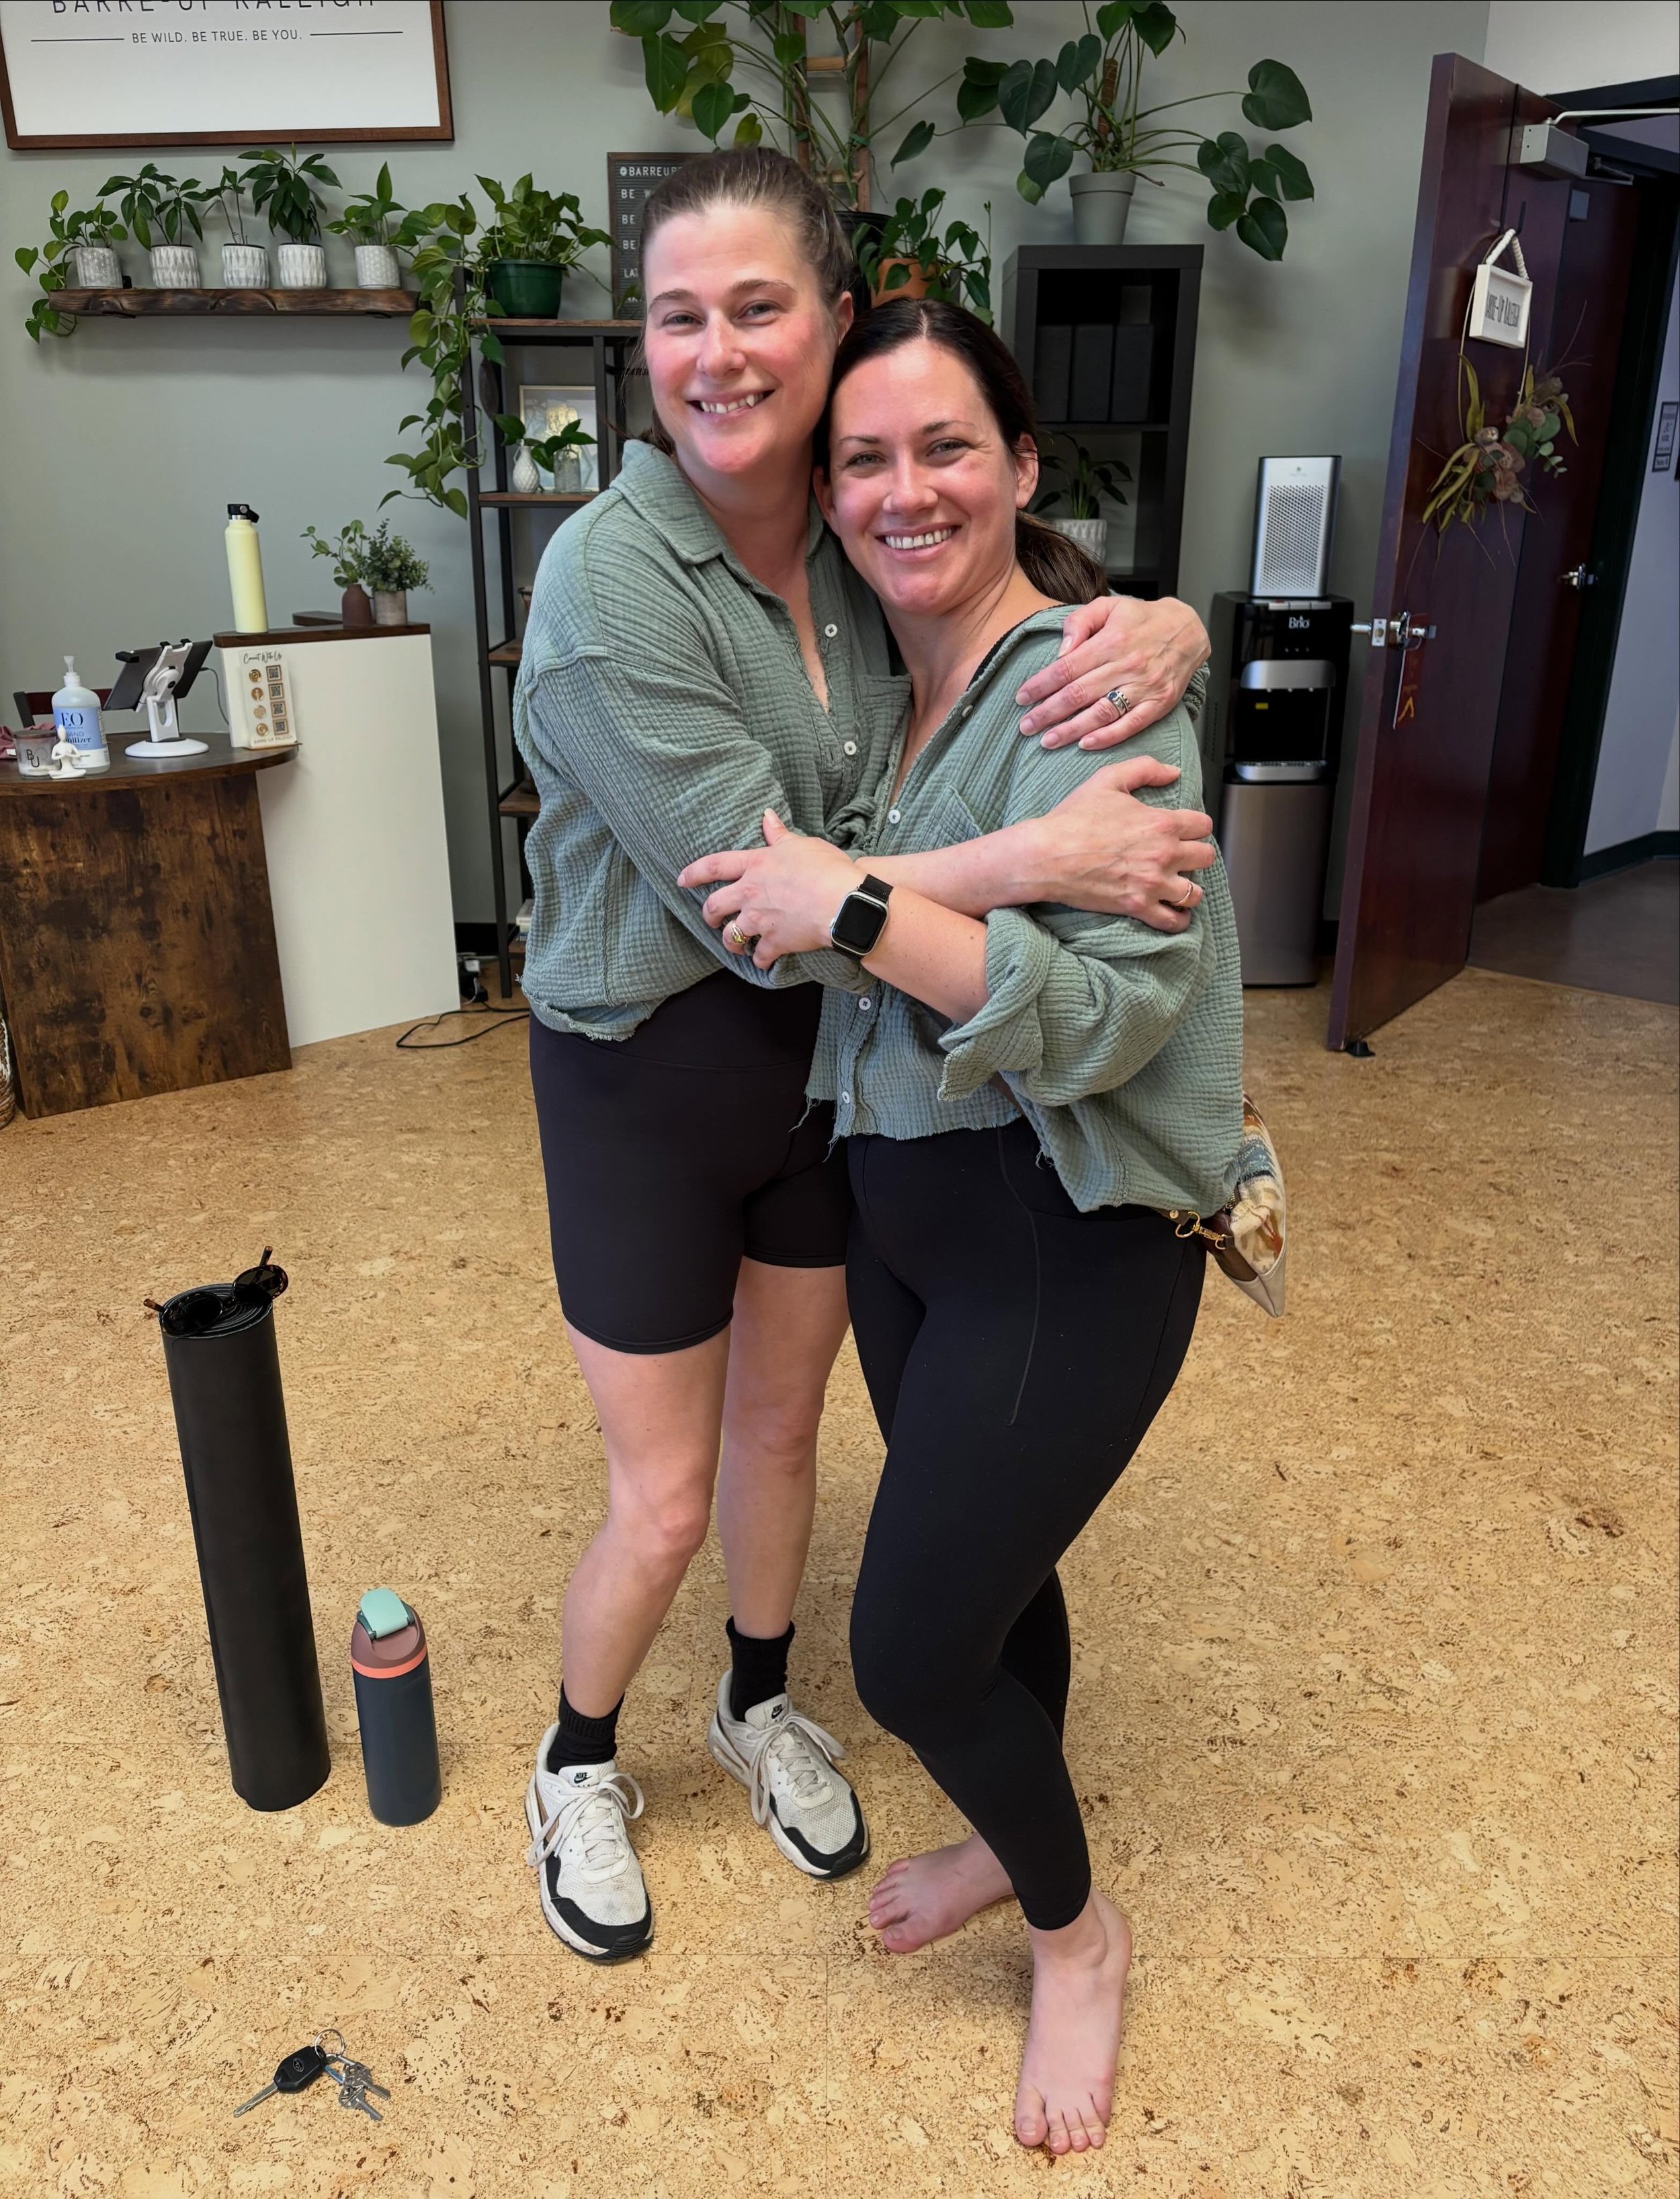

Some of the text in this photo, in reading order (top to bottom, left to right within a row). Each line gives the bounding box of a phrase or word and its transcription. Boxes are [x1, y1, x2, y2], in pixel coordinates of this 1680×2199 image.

[132, 30, 302, 43] BE WILD. BE TRUE. BE YOU.
[621, 189, 635, 199] BE
[622, 214, 636, 224] BE
[622, 240, 636, 249] BE
[61, 712, 83, 726] EO
